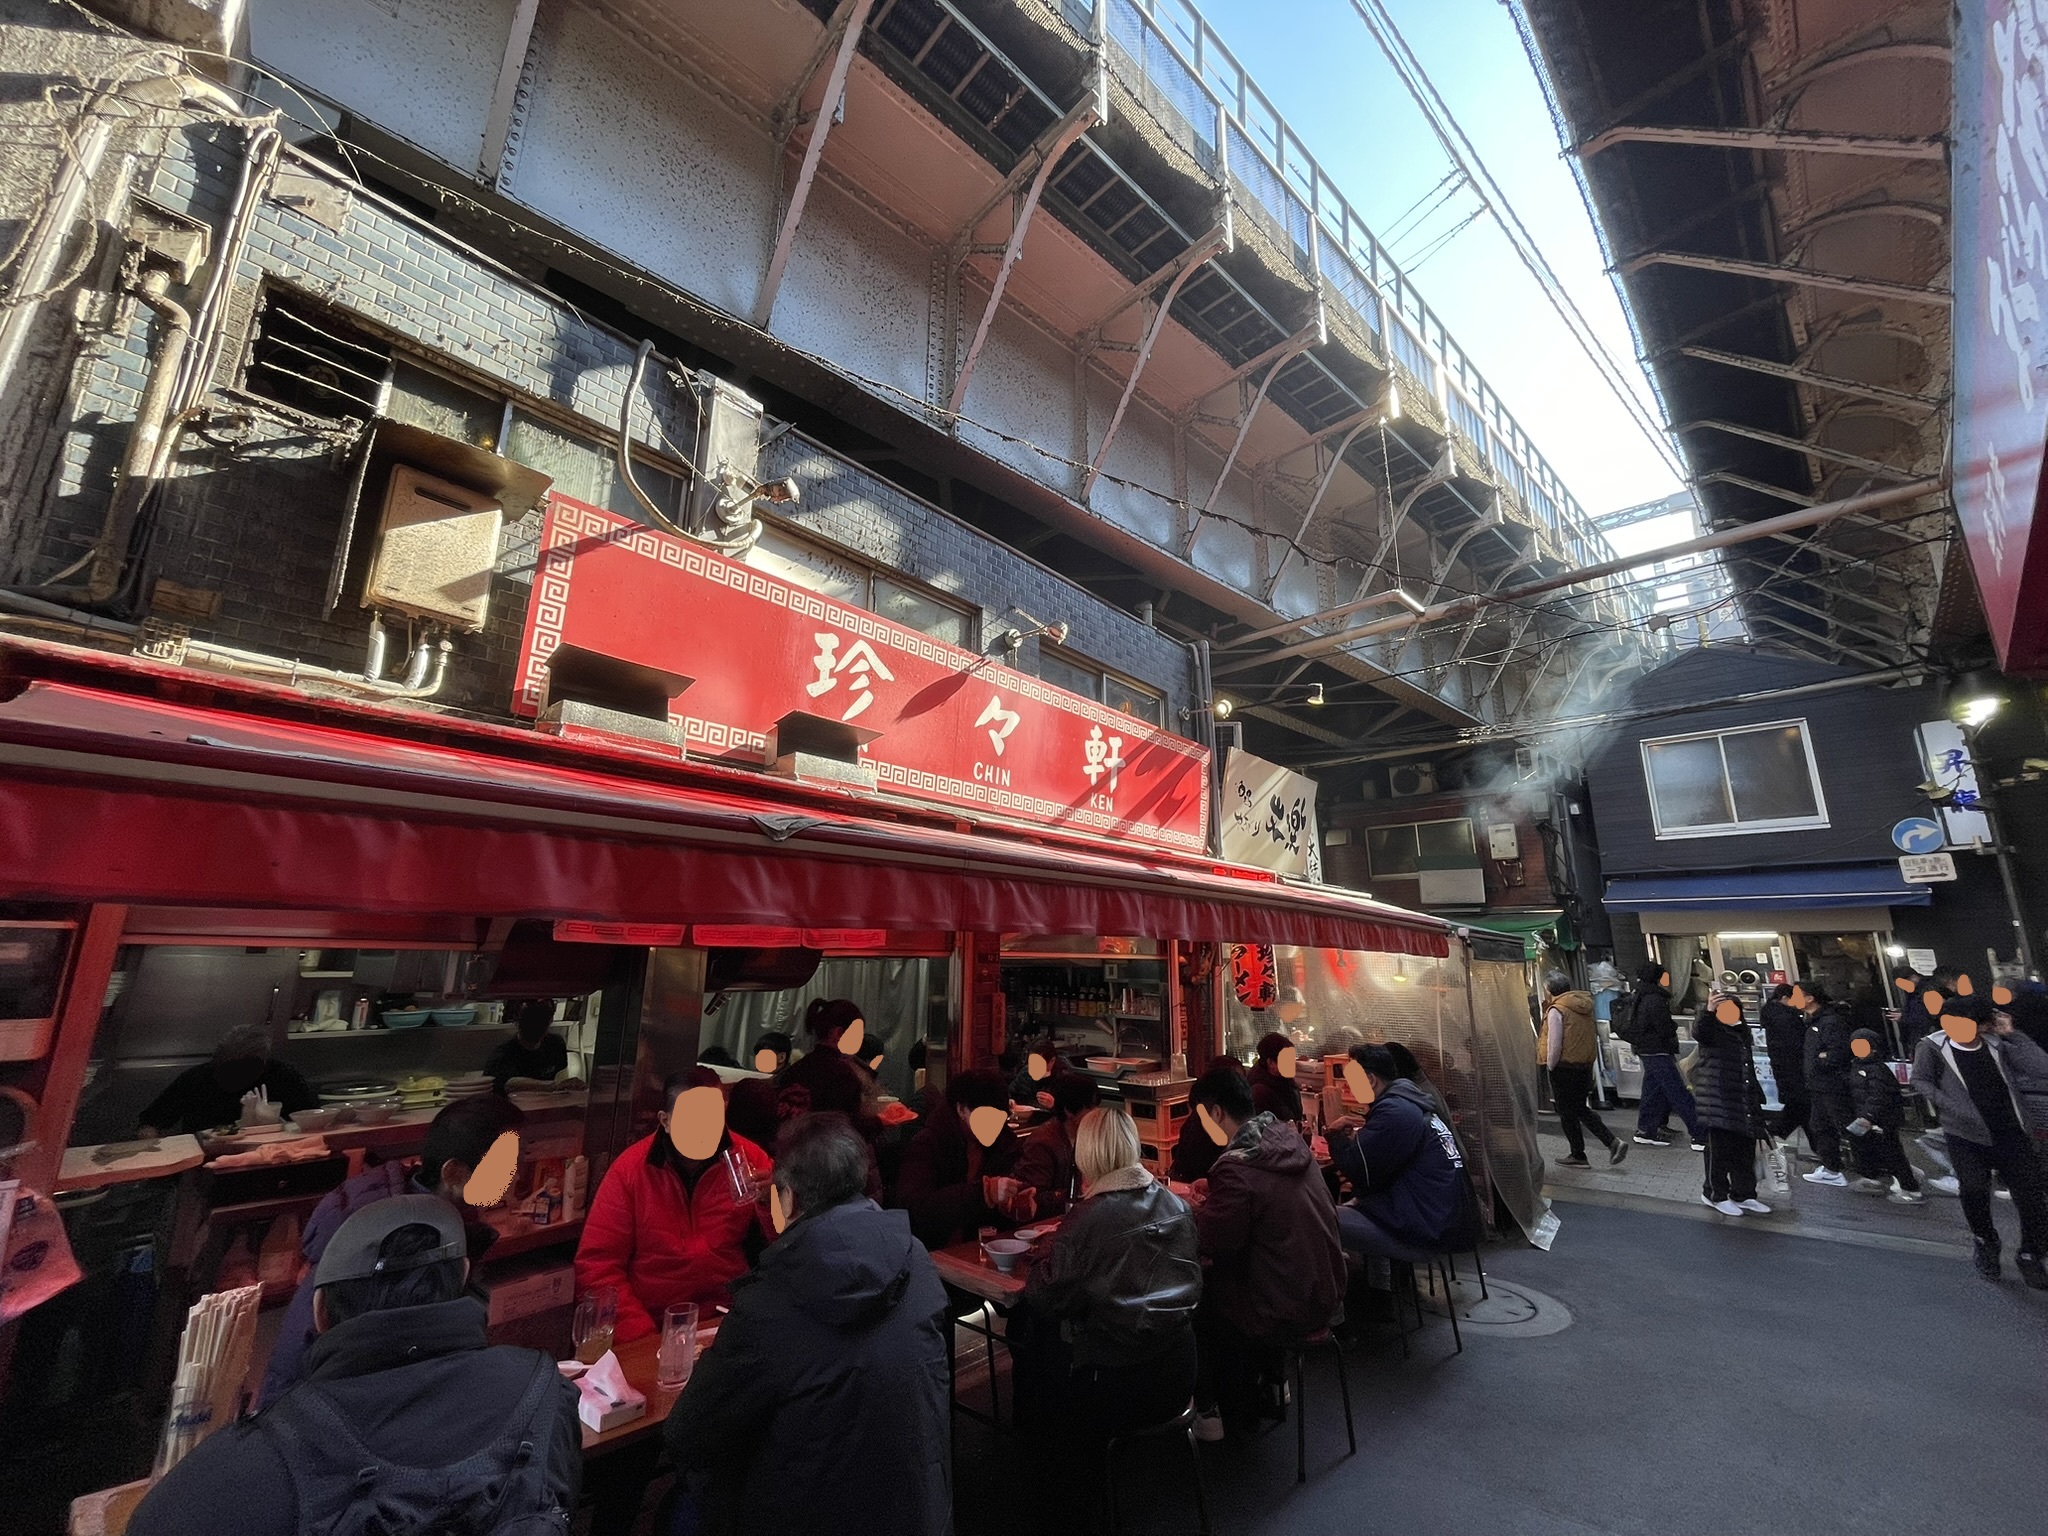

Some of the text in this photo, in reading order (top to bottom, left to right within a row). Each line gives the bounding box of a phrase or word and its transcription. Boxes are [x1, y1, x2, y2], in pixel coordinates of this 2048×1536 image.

[806, 632, 1126, 794] 珍々軒
[973, 762, 1114, 812] CHIN KEN
[1905, 864, 1949, 873] 一方通行
[1231, 944, 1251, 1003] ラーメン
[1257, 944, 1276, 1002] 珍々軒
